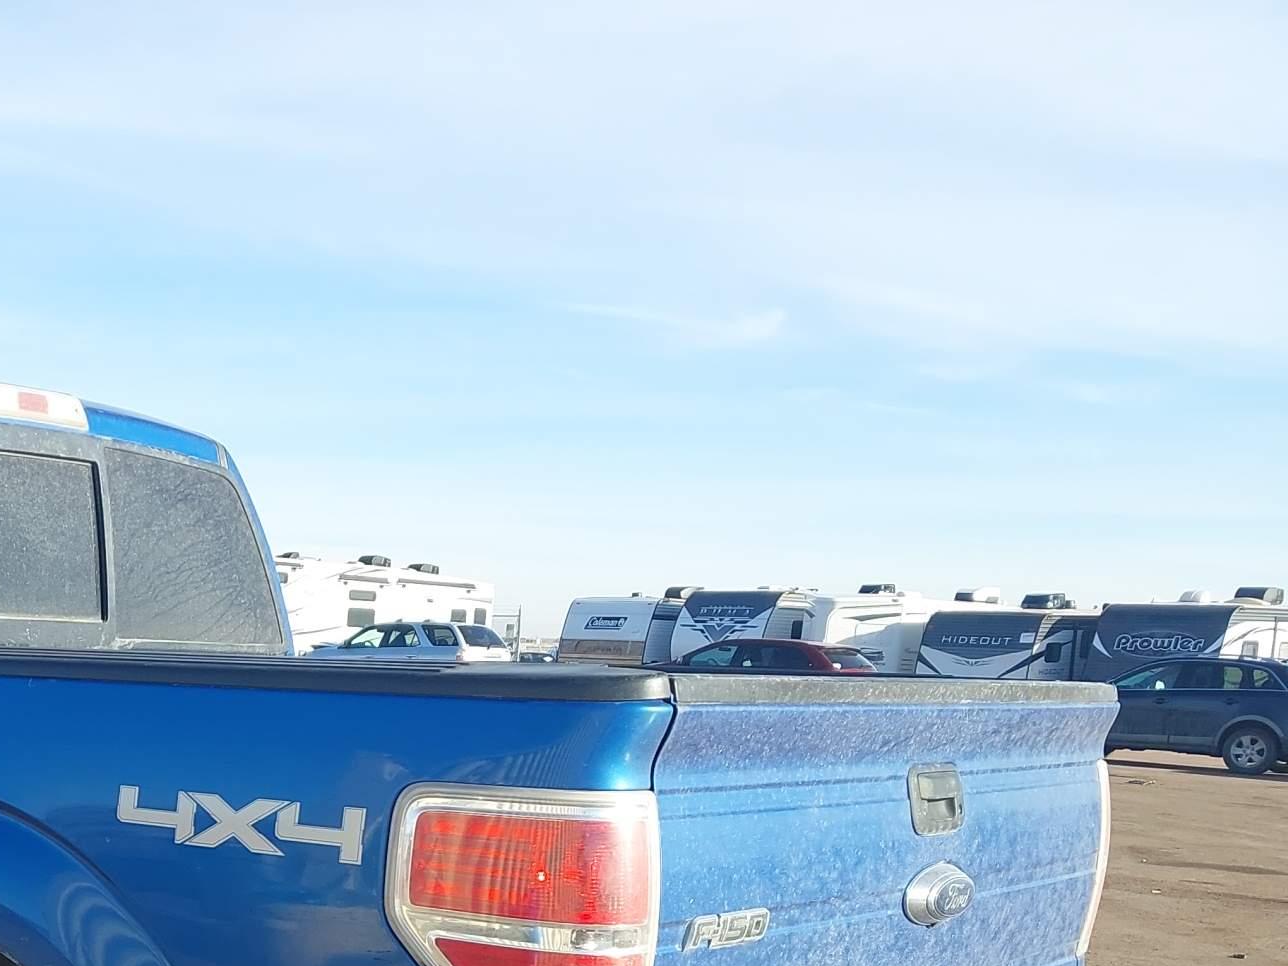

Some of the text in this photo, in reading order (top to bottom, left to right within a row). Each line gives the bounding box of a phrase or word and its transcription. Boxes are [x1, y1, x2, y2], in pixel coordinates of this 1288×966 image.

[941, 635, 1013, 646] HIDEOUT
[1114, 633, 1205, 652] Prowler
[944, 883, 971, 911] Ford
[688, 907, 770, 950] F-150
